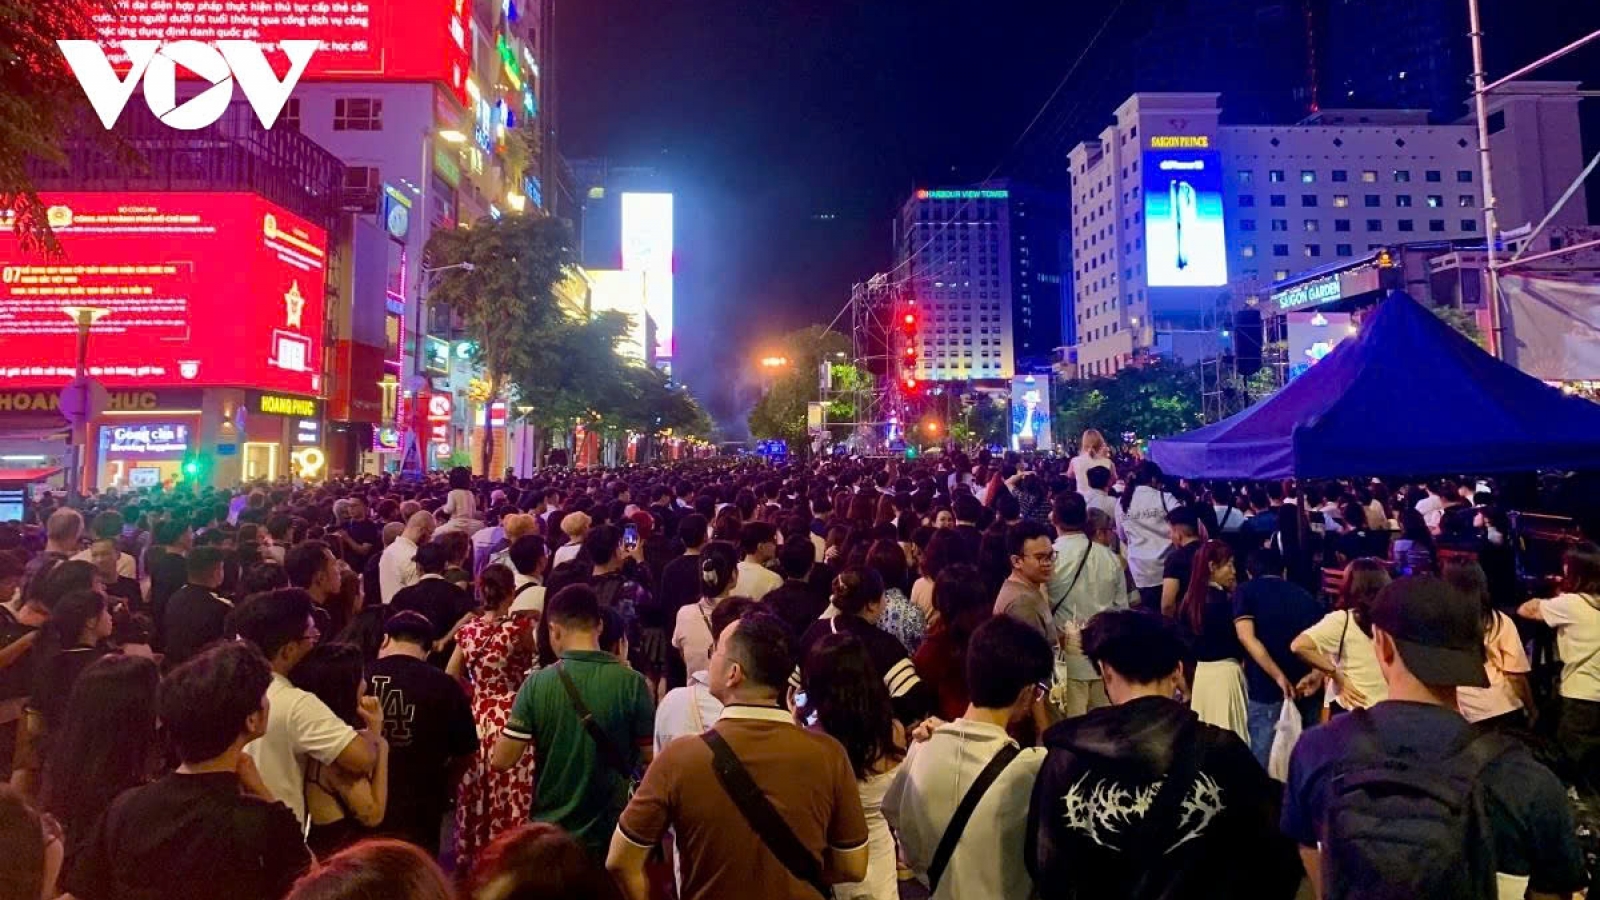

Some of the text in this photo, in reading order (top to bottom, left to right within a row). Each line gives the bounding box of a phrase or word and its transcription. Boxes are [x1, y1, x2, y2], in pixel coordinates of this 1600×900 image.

[1152, 136, 1208, 148] SAIGON PRINCE
[1308, 280, 1340, 301] GARDEN
